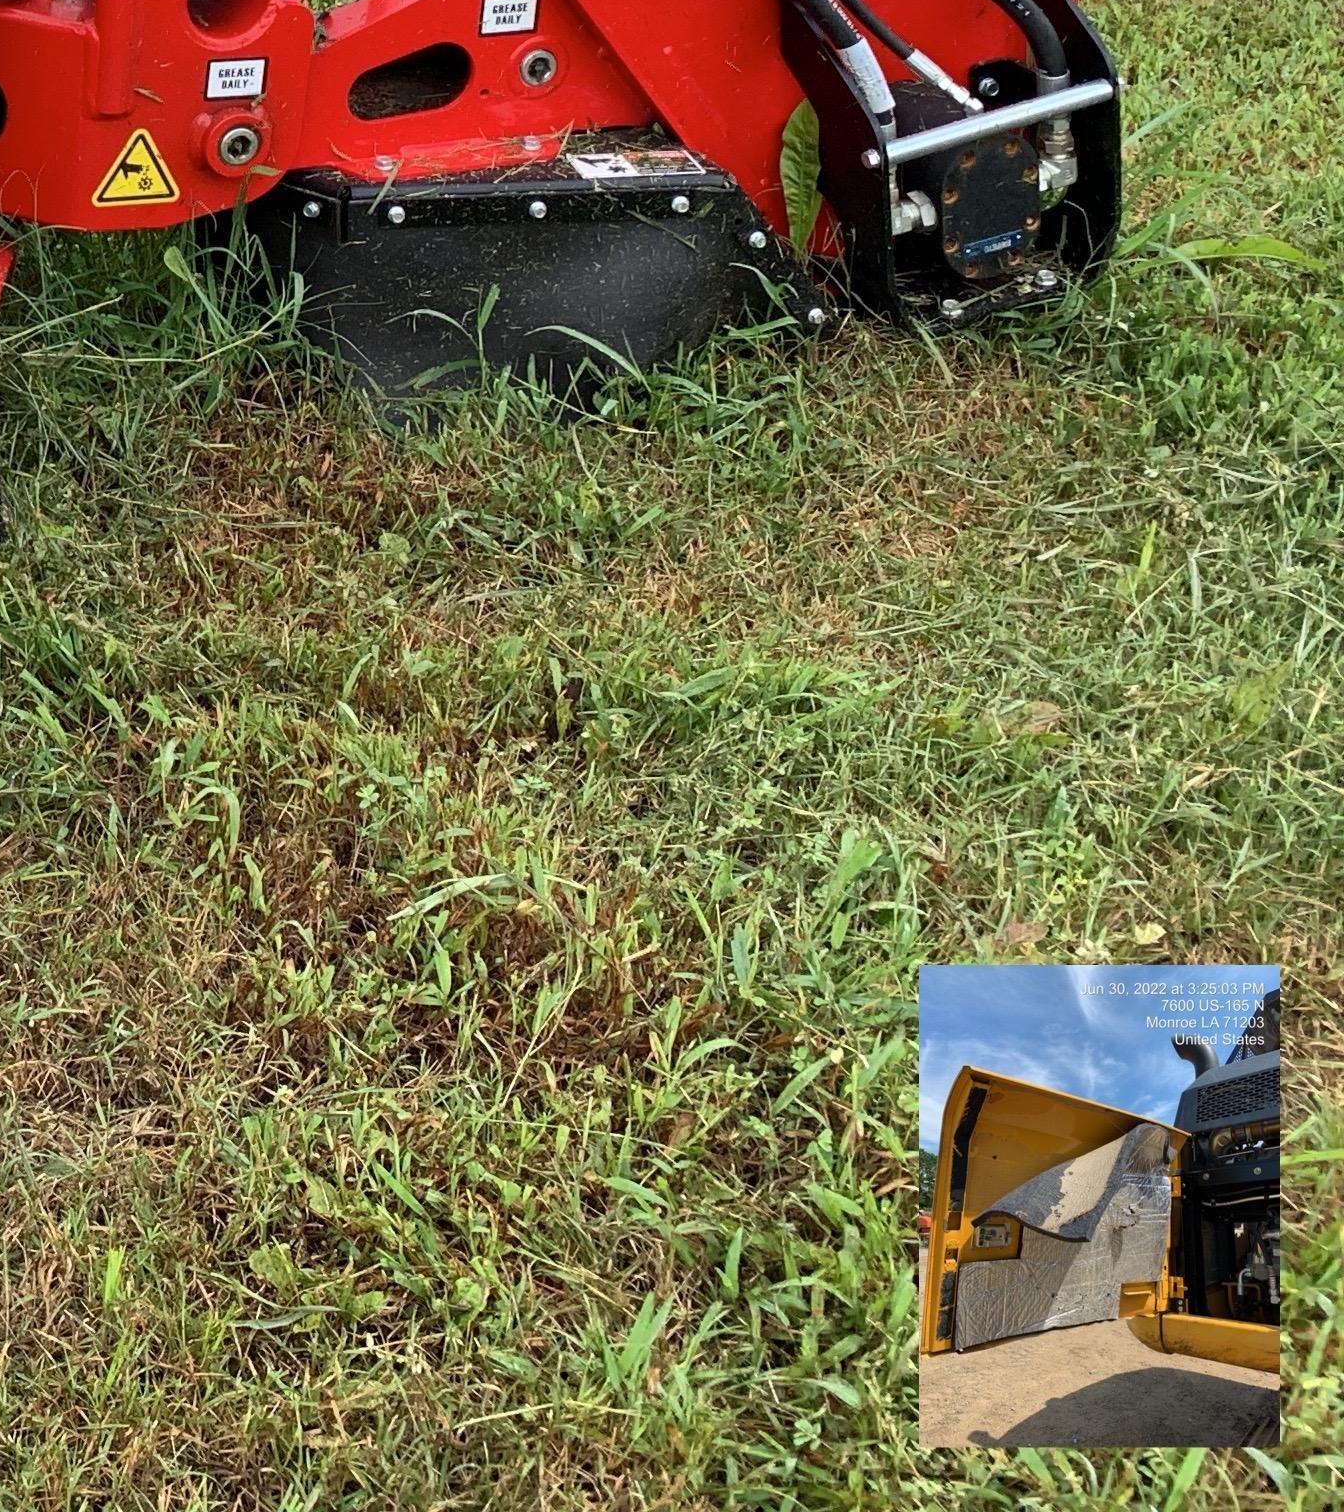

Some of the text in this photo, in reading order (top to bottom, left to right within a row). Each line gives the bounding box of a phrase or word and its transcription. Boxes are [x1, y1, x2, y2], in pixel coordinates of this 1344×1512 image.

[492, 2, 529, 14] GREASE
[495, 14, 522, 26] DAILY
[218, 67, 256, 79] GREASE
[221, 79, 249, 90] DAILY
